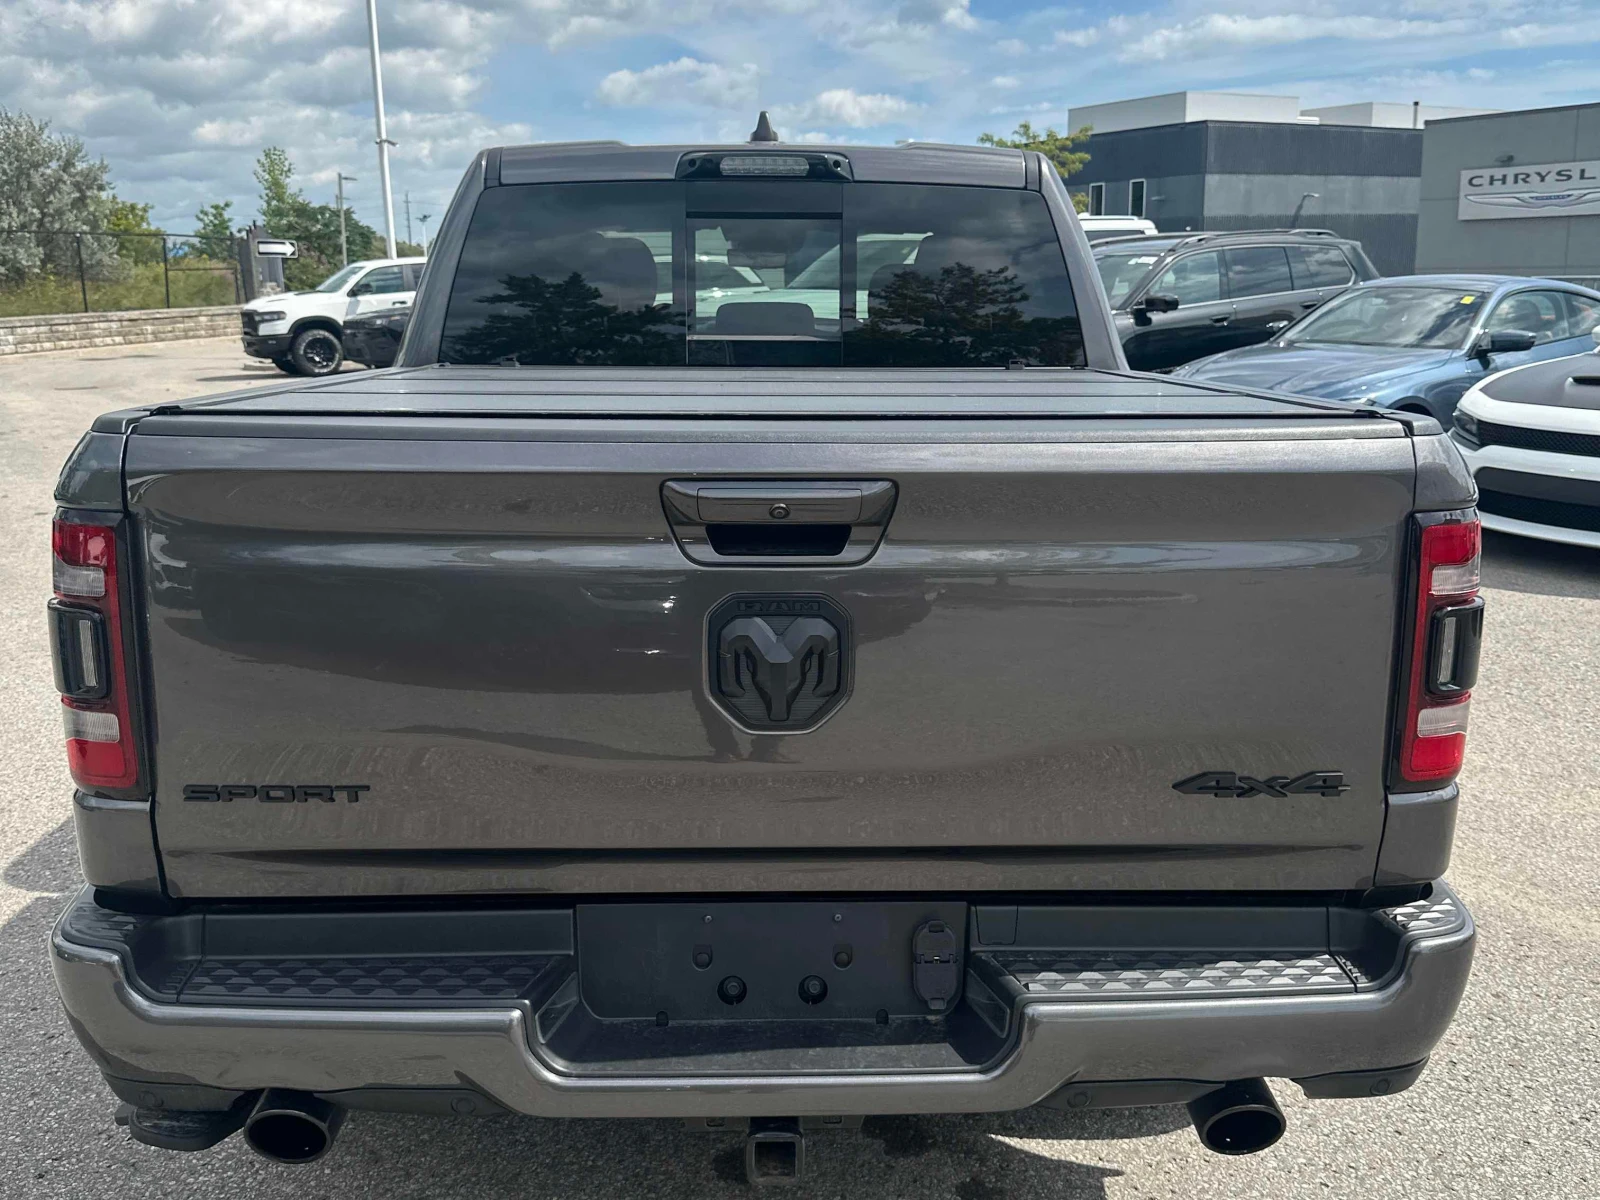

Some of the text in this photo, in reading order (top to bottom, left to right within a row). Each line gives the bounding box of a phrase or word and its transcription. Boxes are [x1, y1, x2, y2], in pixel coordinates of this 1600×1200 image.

[1468, 168, 1597, 188] CHRYSL
[737, 601, 820, 612] RAM
[183, 784, 370, 803] SPORT
